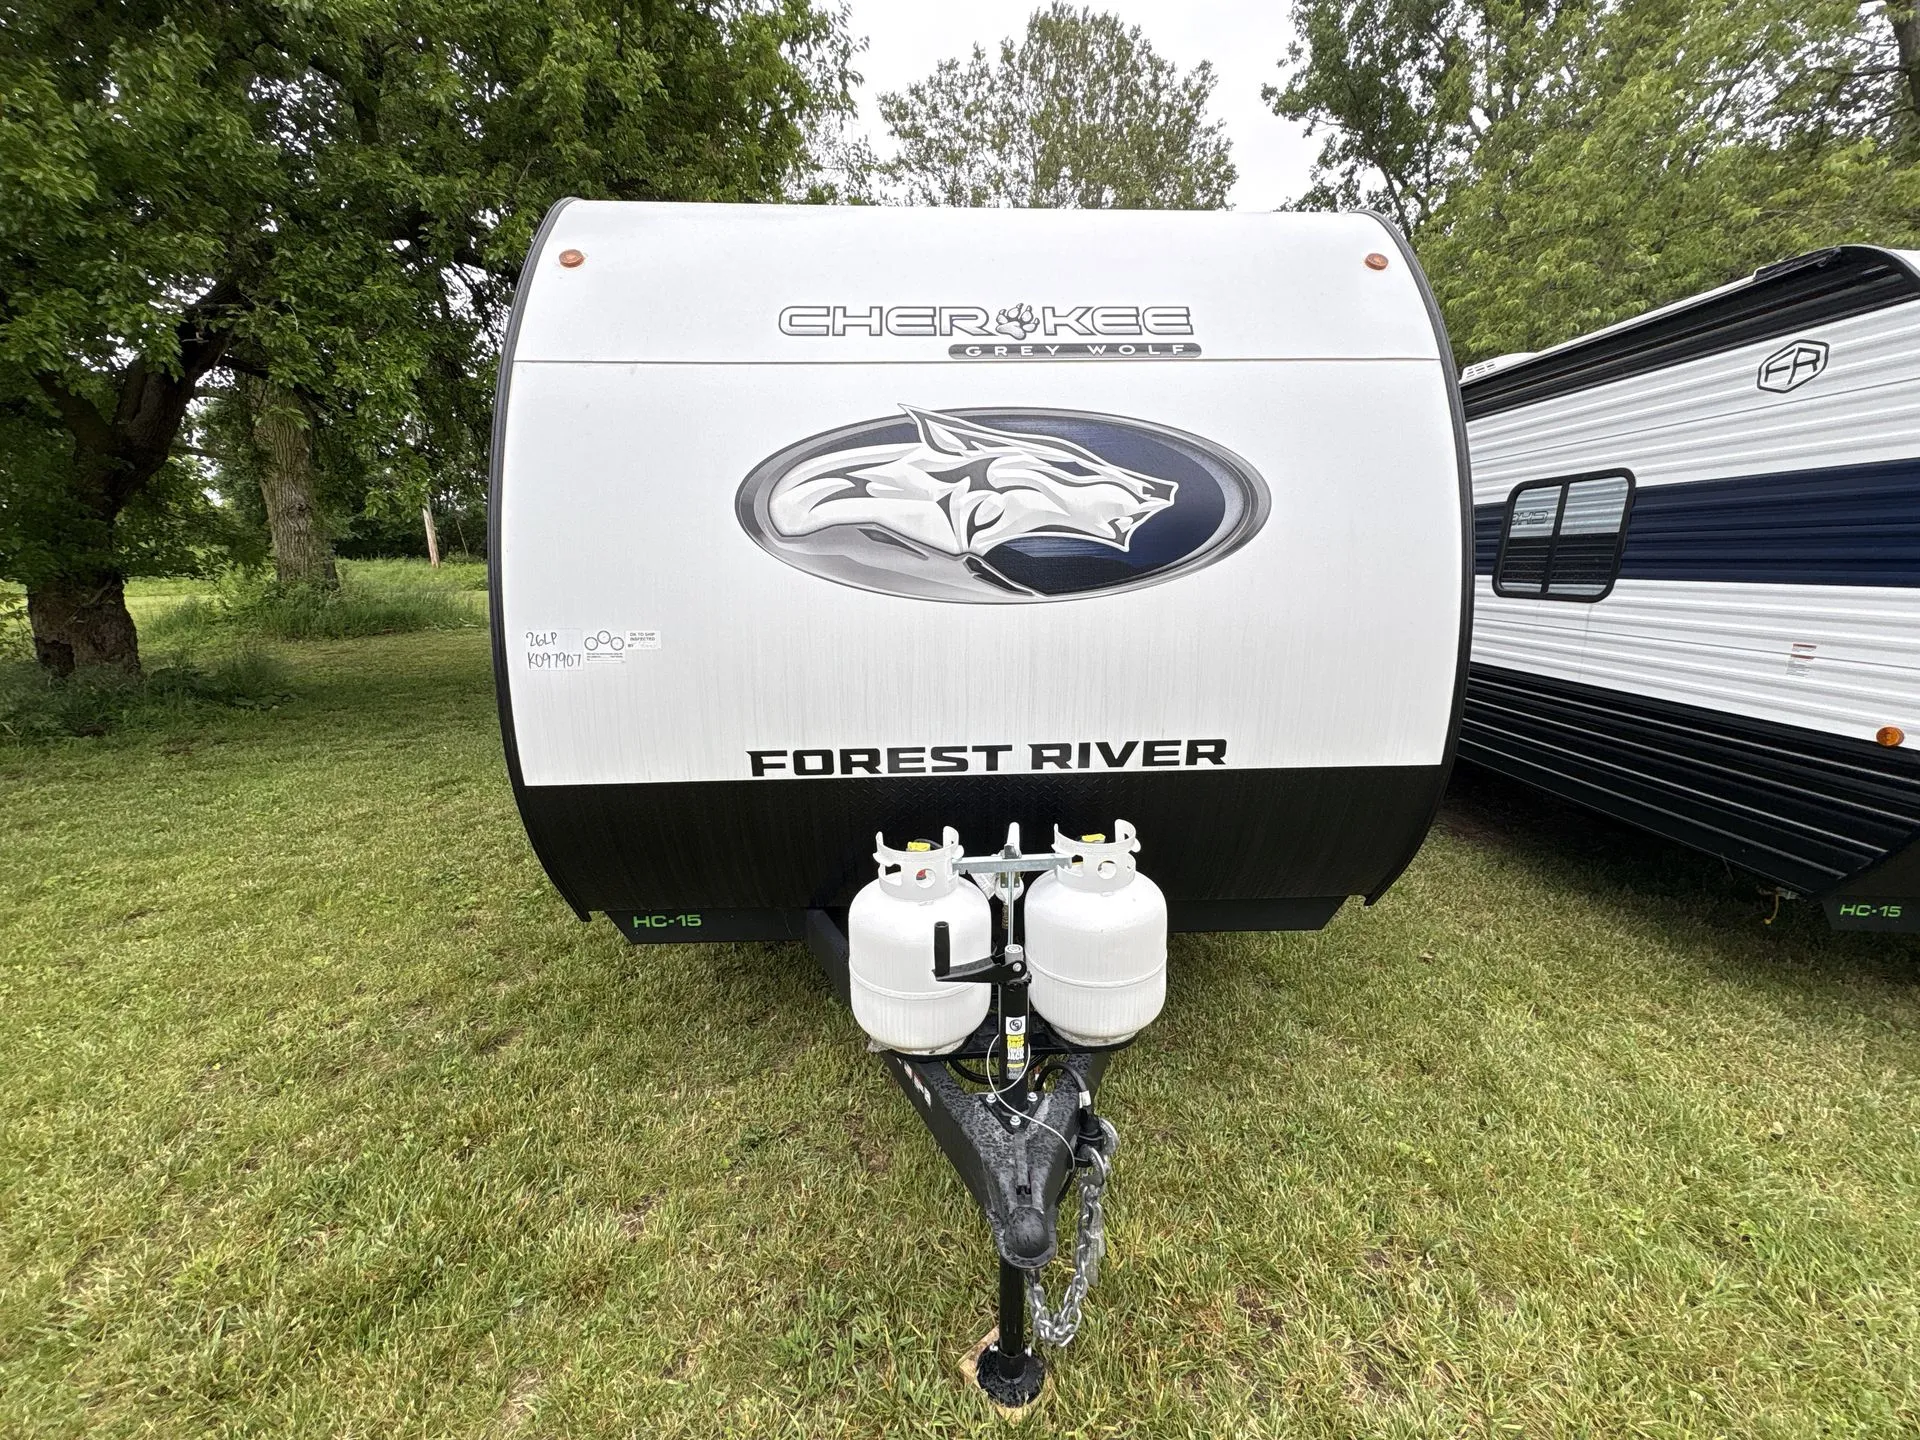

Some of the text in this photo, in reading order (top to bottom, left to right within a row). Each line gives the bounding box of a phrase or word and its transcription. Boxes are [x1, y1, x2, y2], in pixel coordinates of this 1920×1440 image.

[778, 304, 1195, 338] CHEROKEE
[965, 345, 1185, 357] GREY WOLF
[1764, 347, 1821, 386] FR
[525, 631, 558, 647] 26LP
[527, 652, 582, 670] K097907
[745, 738, 1227, 777] FOREST RIVER
[1840, 904, 1903, 918] HC-15
[633, 914, 702, 928] HC-15
